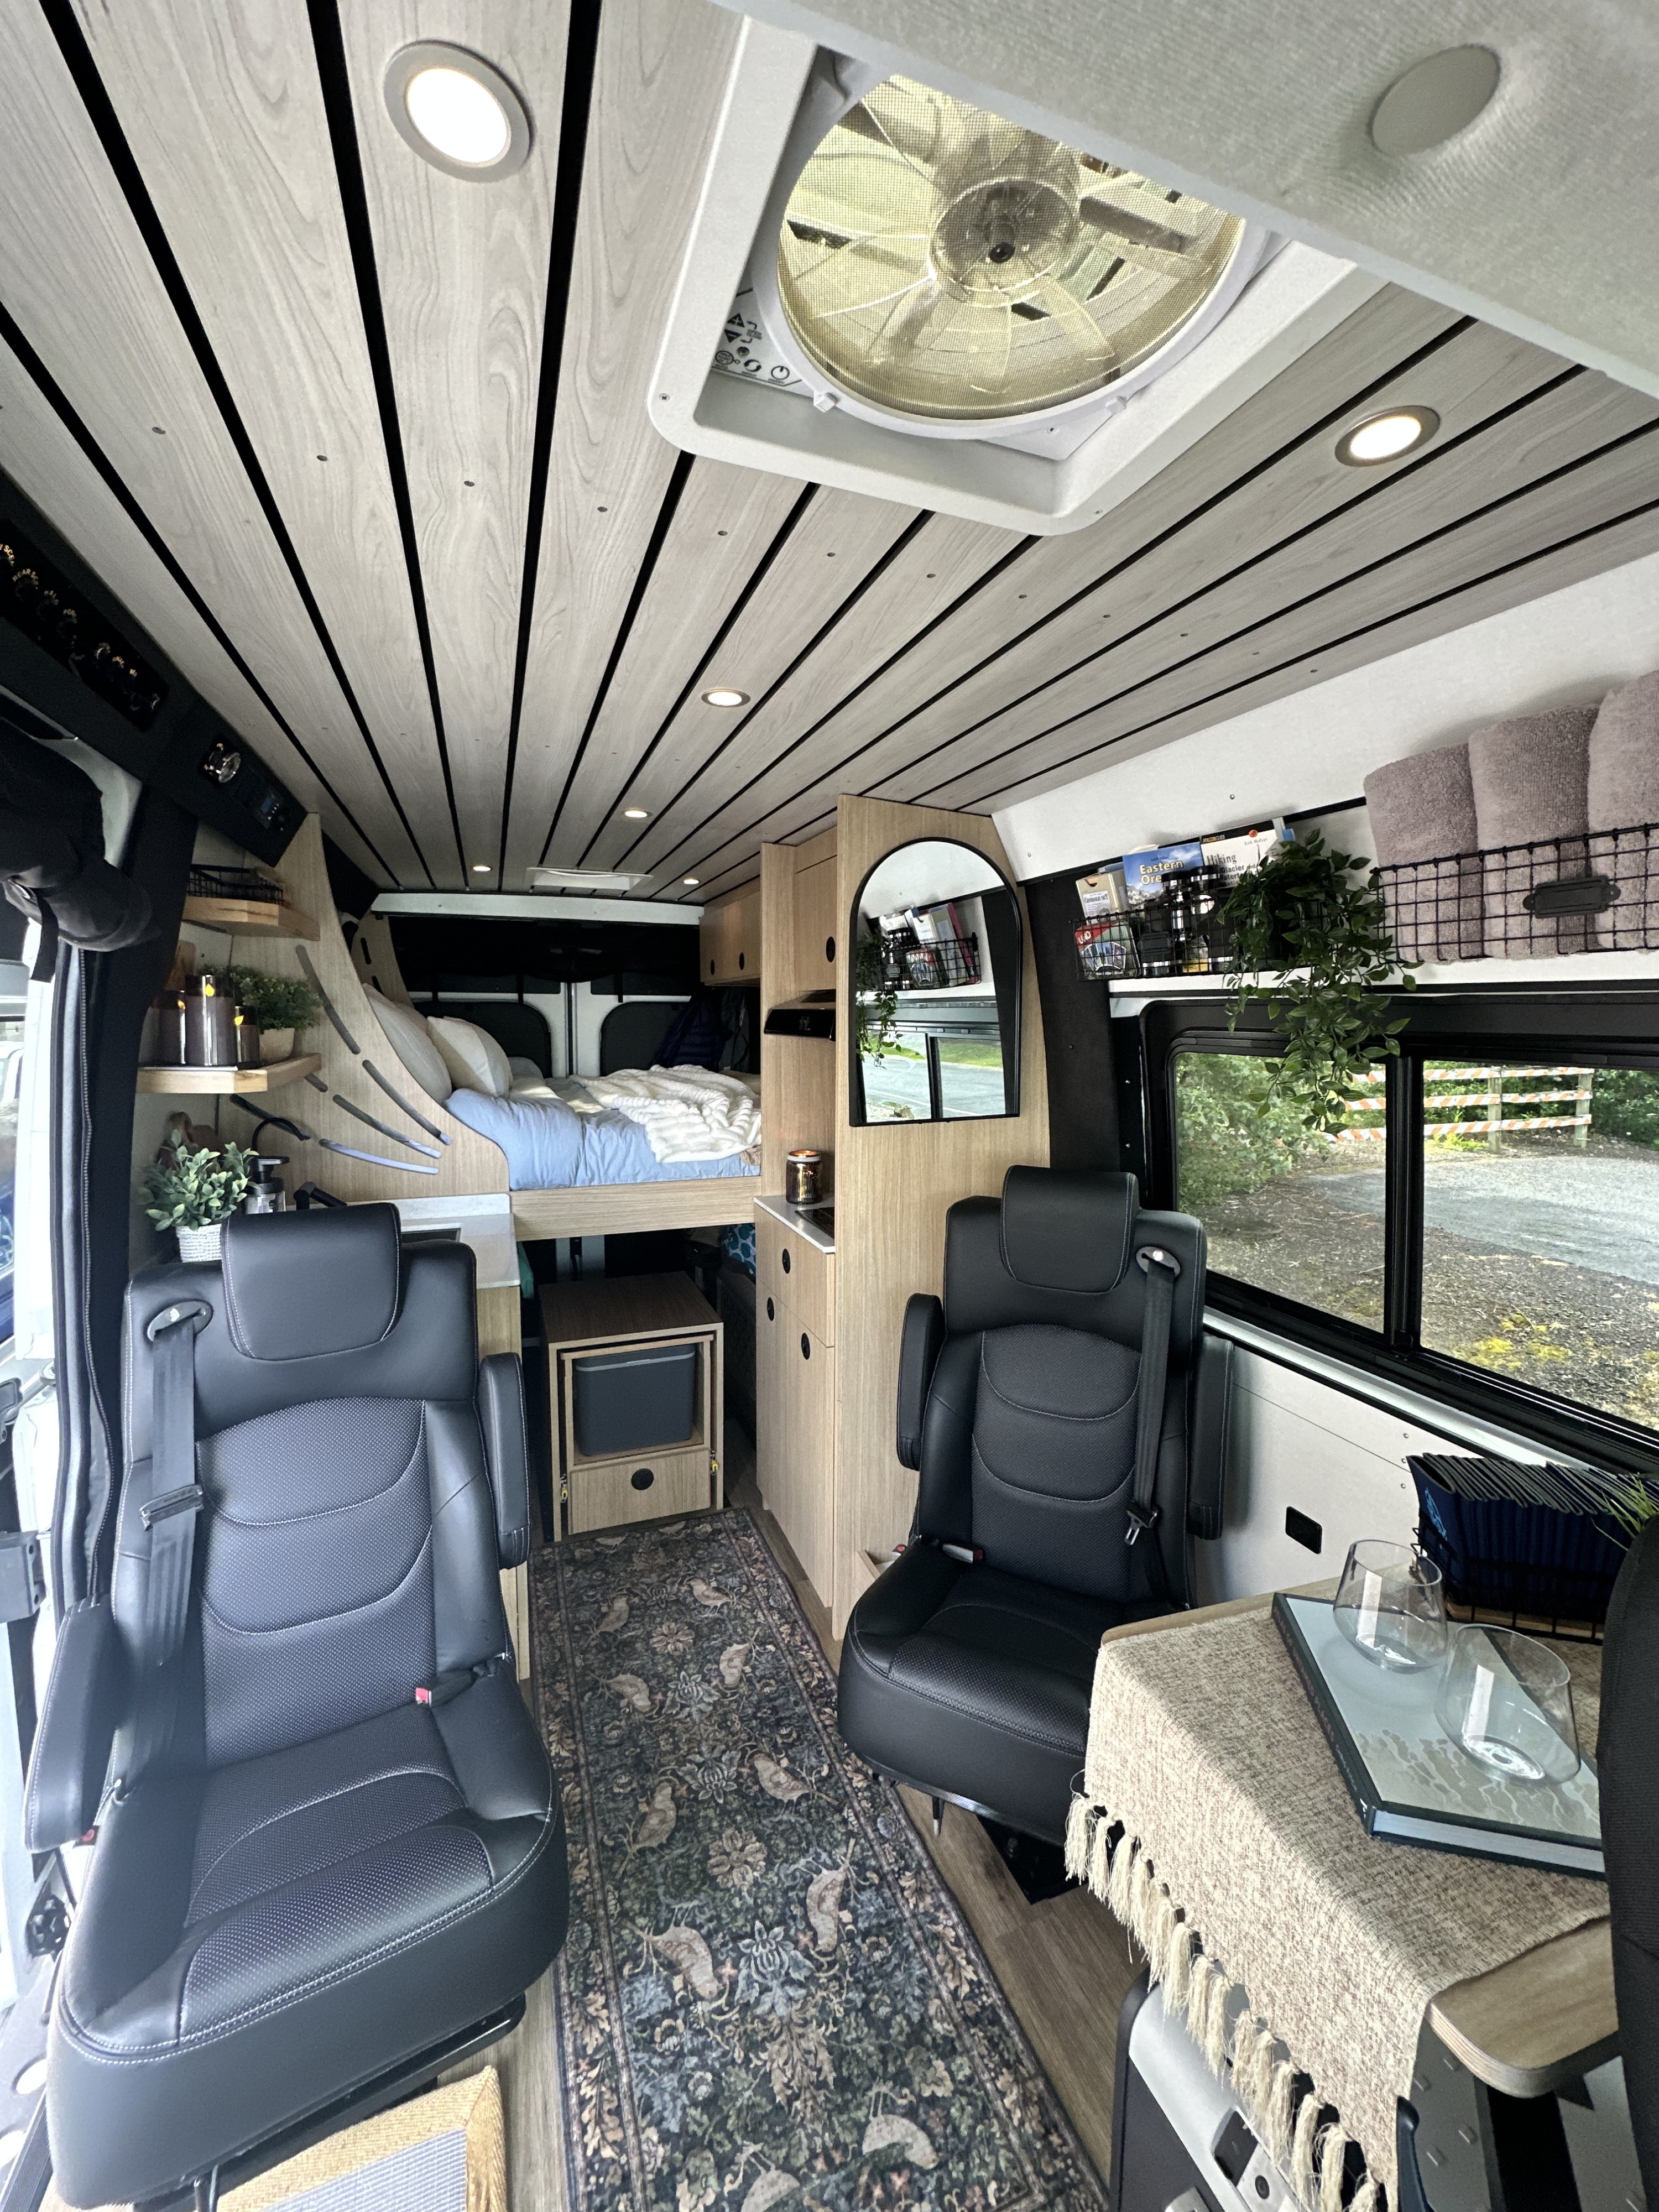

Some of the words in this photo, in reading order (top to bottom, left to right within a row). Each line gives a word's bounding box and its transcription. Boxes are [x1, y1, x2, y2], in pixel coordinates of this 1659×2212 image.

[1207, 854, 1237, 866] Hiking
[1139, 860, 1184, 874] Eastern
[1221, 865, 1245, 873] Glacier
[1141, 874, 1162, 885] Ore
[1078, 931, 1092, 945] UNO
